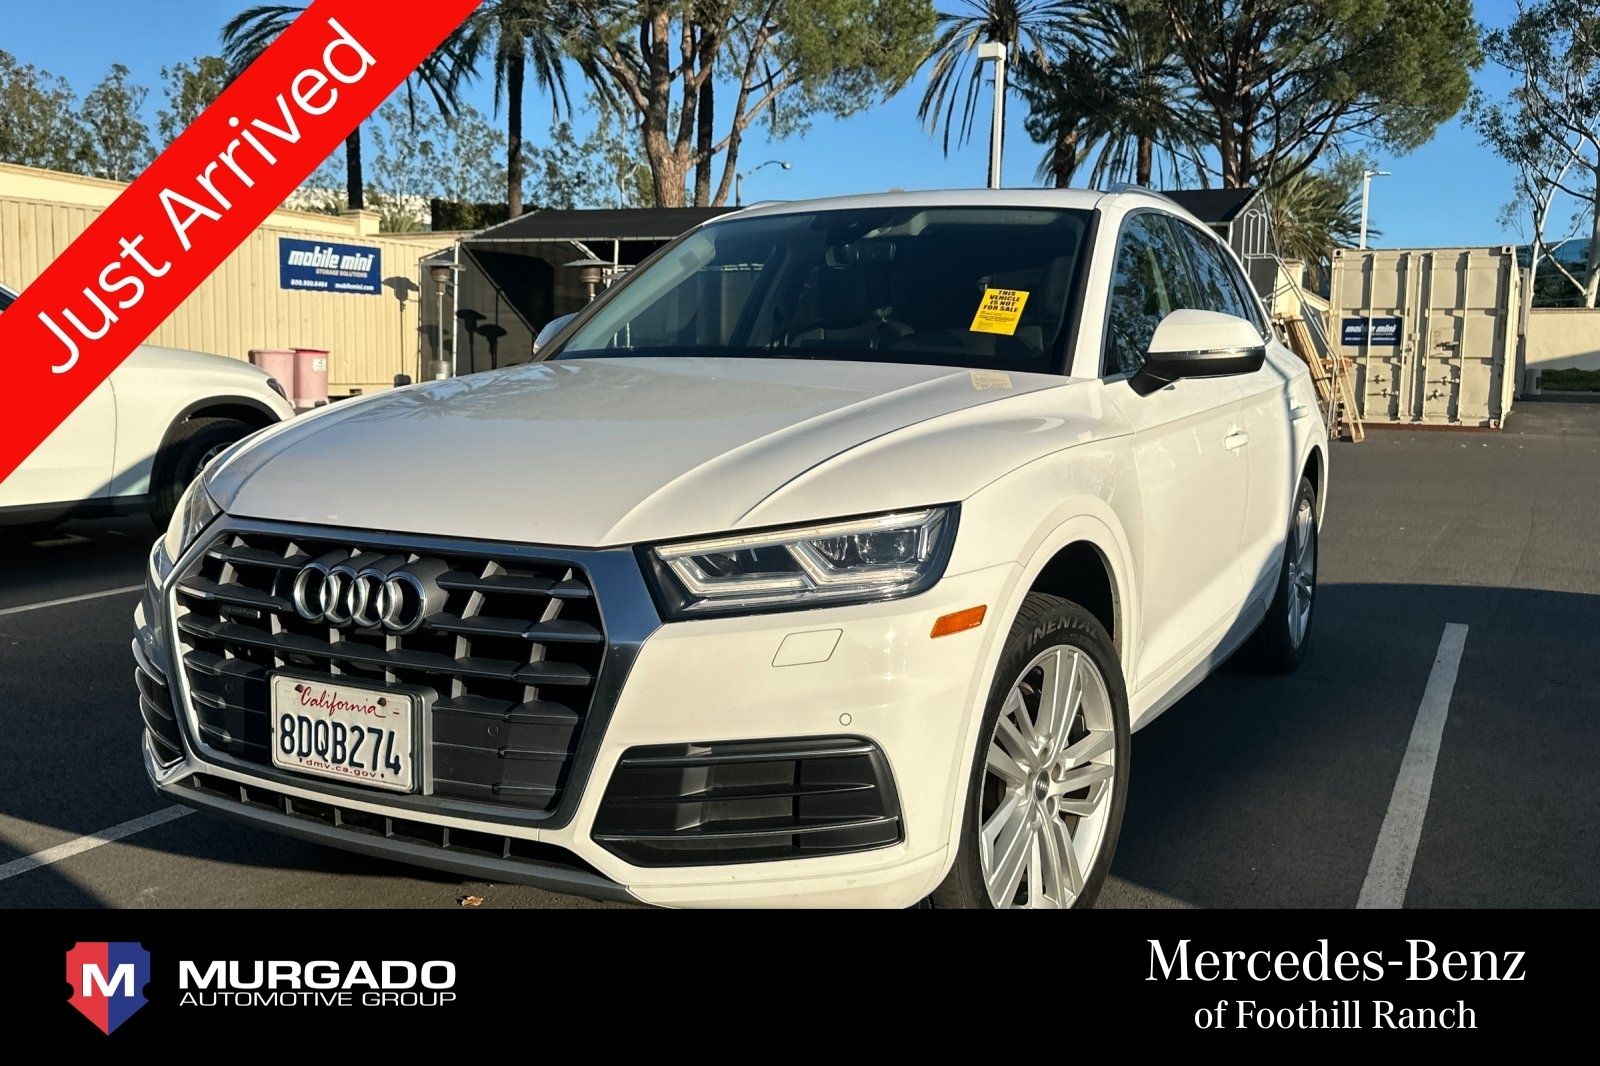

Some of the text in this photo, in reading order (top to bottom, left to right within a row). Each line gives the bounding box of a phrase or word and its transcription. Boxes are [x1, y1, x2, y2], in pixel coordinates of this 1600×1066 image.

[287, 246, 374, 272] mobile mini
[315, 268, 368, 279] STORAGE SOLUTIONS
[989, 294, 1021, 302] VEHICLE
[301, 686, 386, 718] California
[280, 713, 401, 775] 8DQB274
[306, 759, 377, 778] dmv.ca.gov
